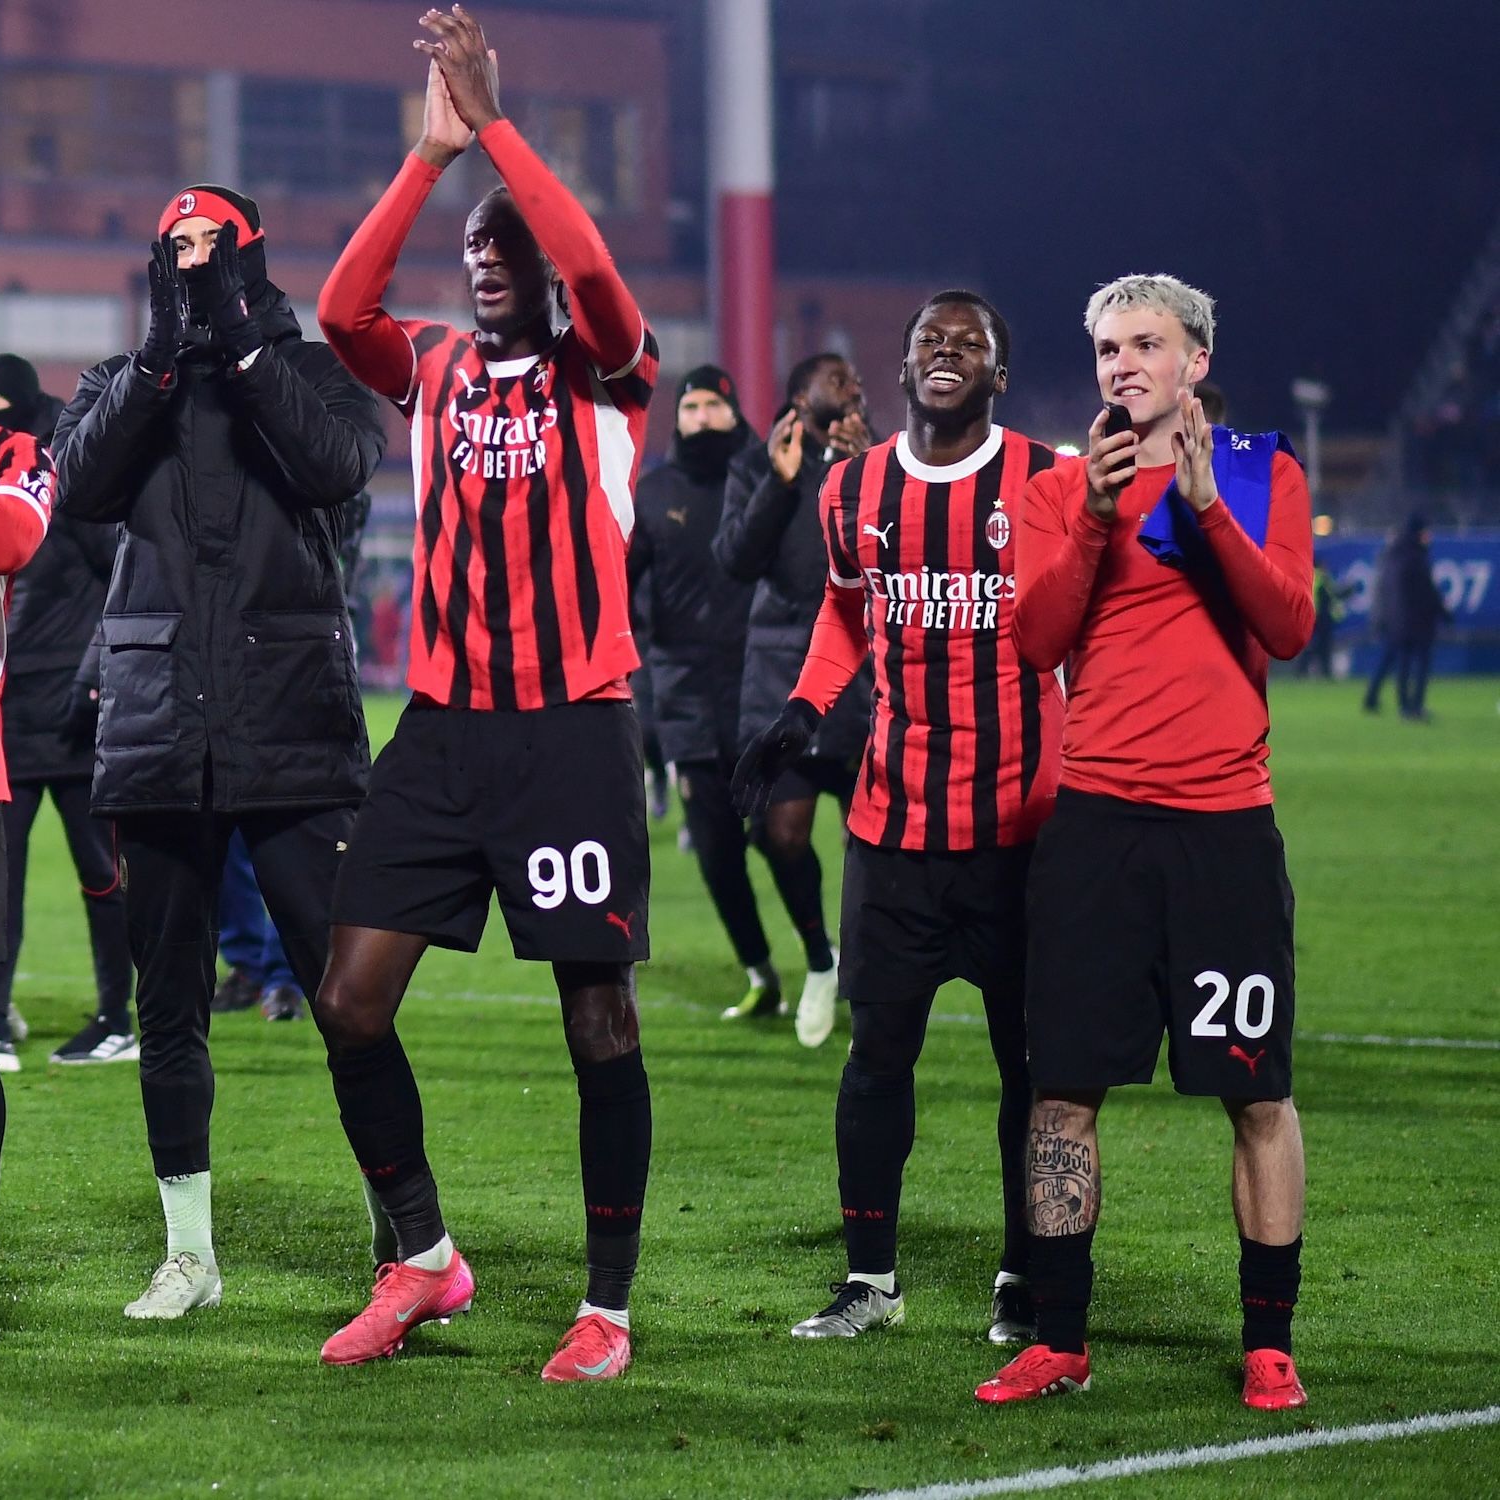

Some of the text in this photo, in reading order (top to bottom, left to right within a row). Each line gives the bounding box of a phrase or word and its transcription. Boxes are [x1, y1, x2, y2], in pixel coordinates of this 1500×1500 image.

[863, 565, 1015, 601] Emirates
[886, 600, 997, 630] FLY BETTER
[527, 840, 611, 909] 90
[1191, 970, 1275, 1038] 20
